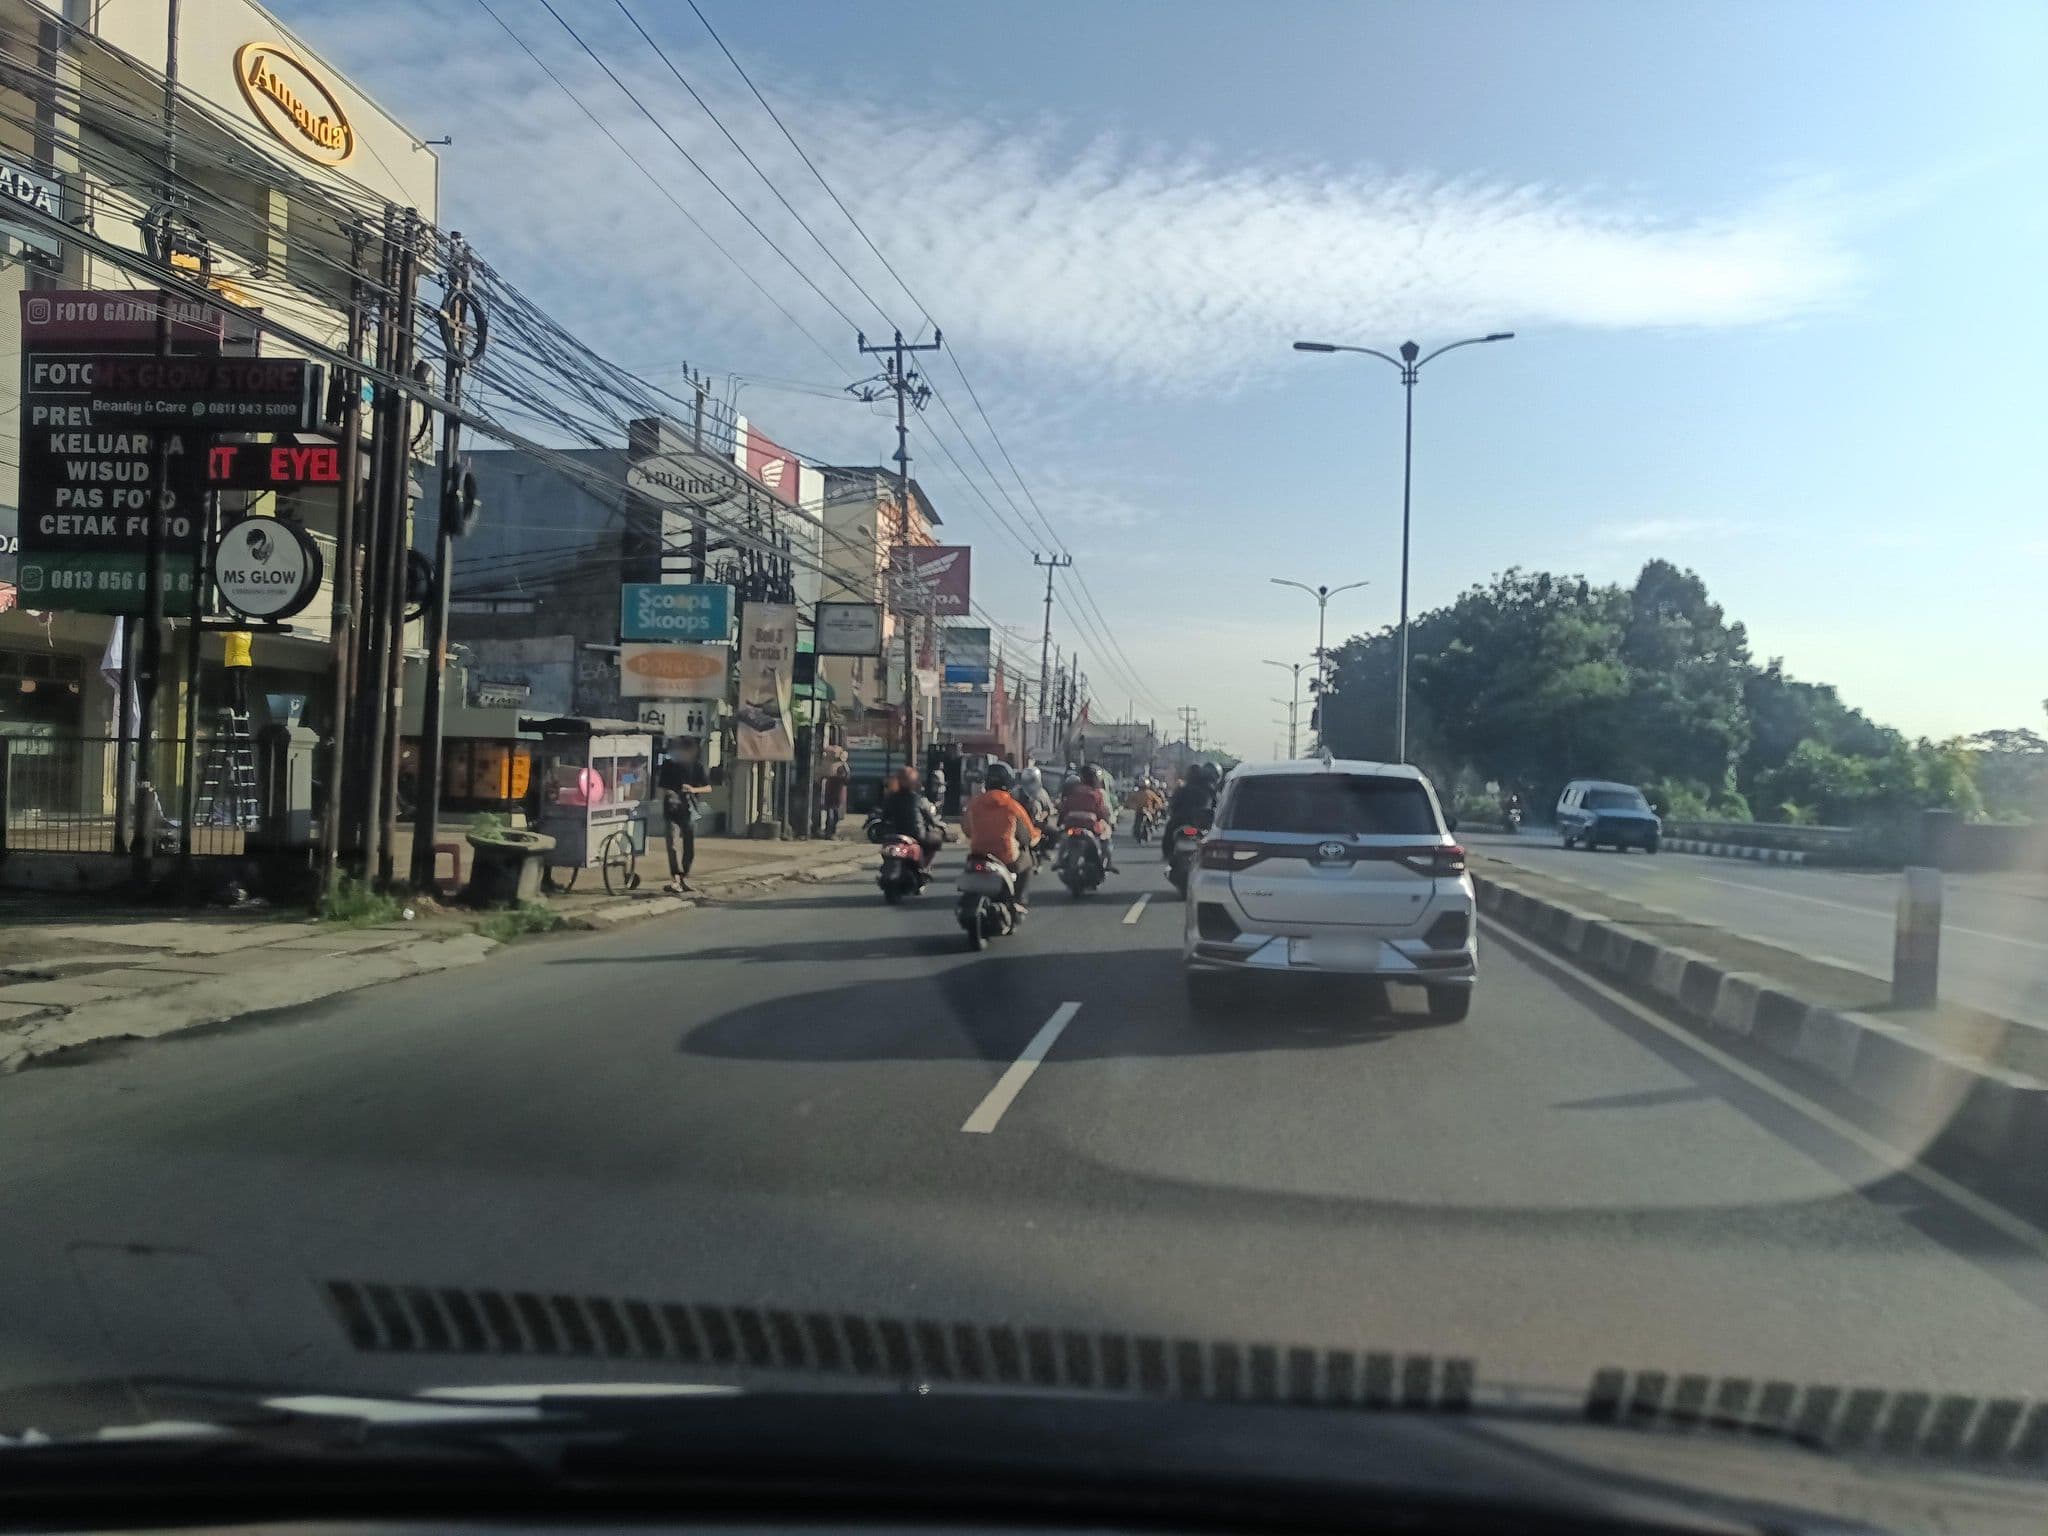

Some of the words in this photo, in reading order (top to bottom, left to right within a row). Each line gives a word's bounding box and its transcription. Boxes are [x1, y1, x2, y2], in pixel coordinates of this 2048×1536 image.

[248, 55, 344, 150] Amanda
[56, 303, 98, 321] FOTO
[93, 400, 142, 415] Beauty
[155, 401, 186, 413] Care
[209, 401, 237, 414] 0811
[50, 434, 184, 454] KELUARA
[56, 488, 104, 508] PAS
[40, 515, 117, 535] CETAK
[51, 571, 93, 589] 0813
[224, 570, 245, 584] MS
[250, 571, 296, 584] GLOW
[638, 609, 710, 633] Skoops
